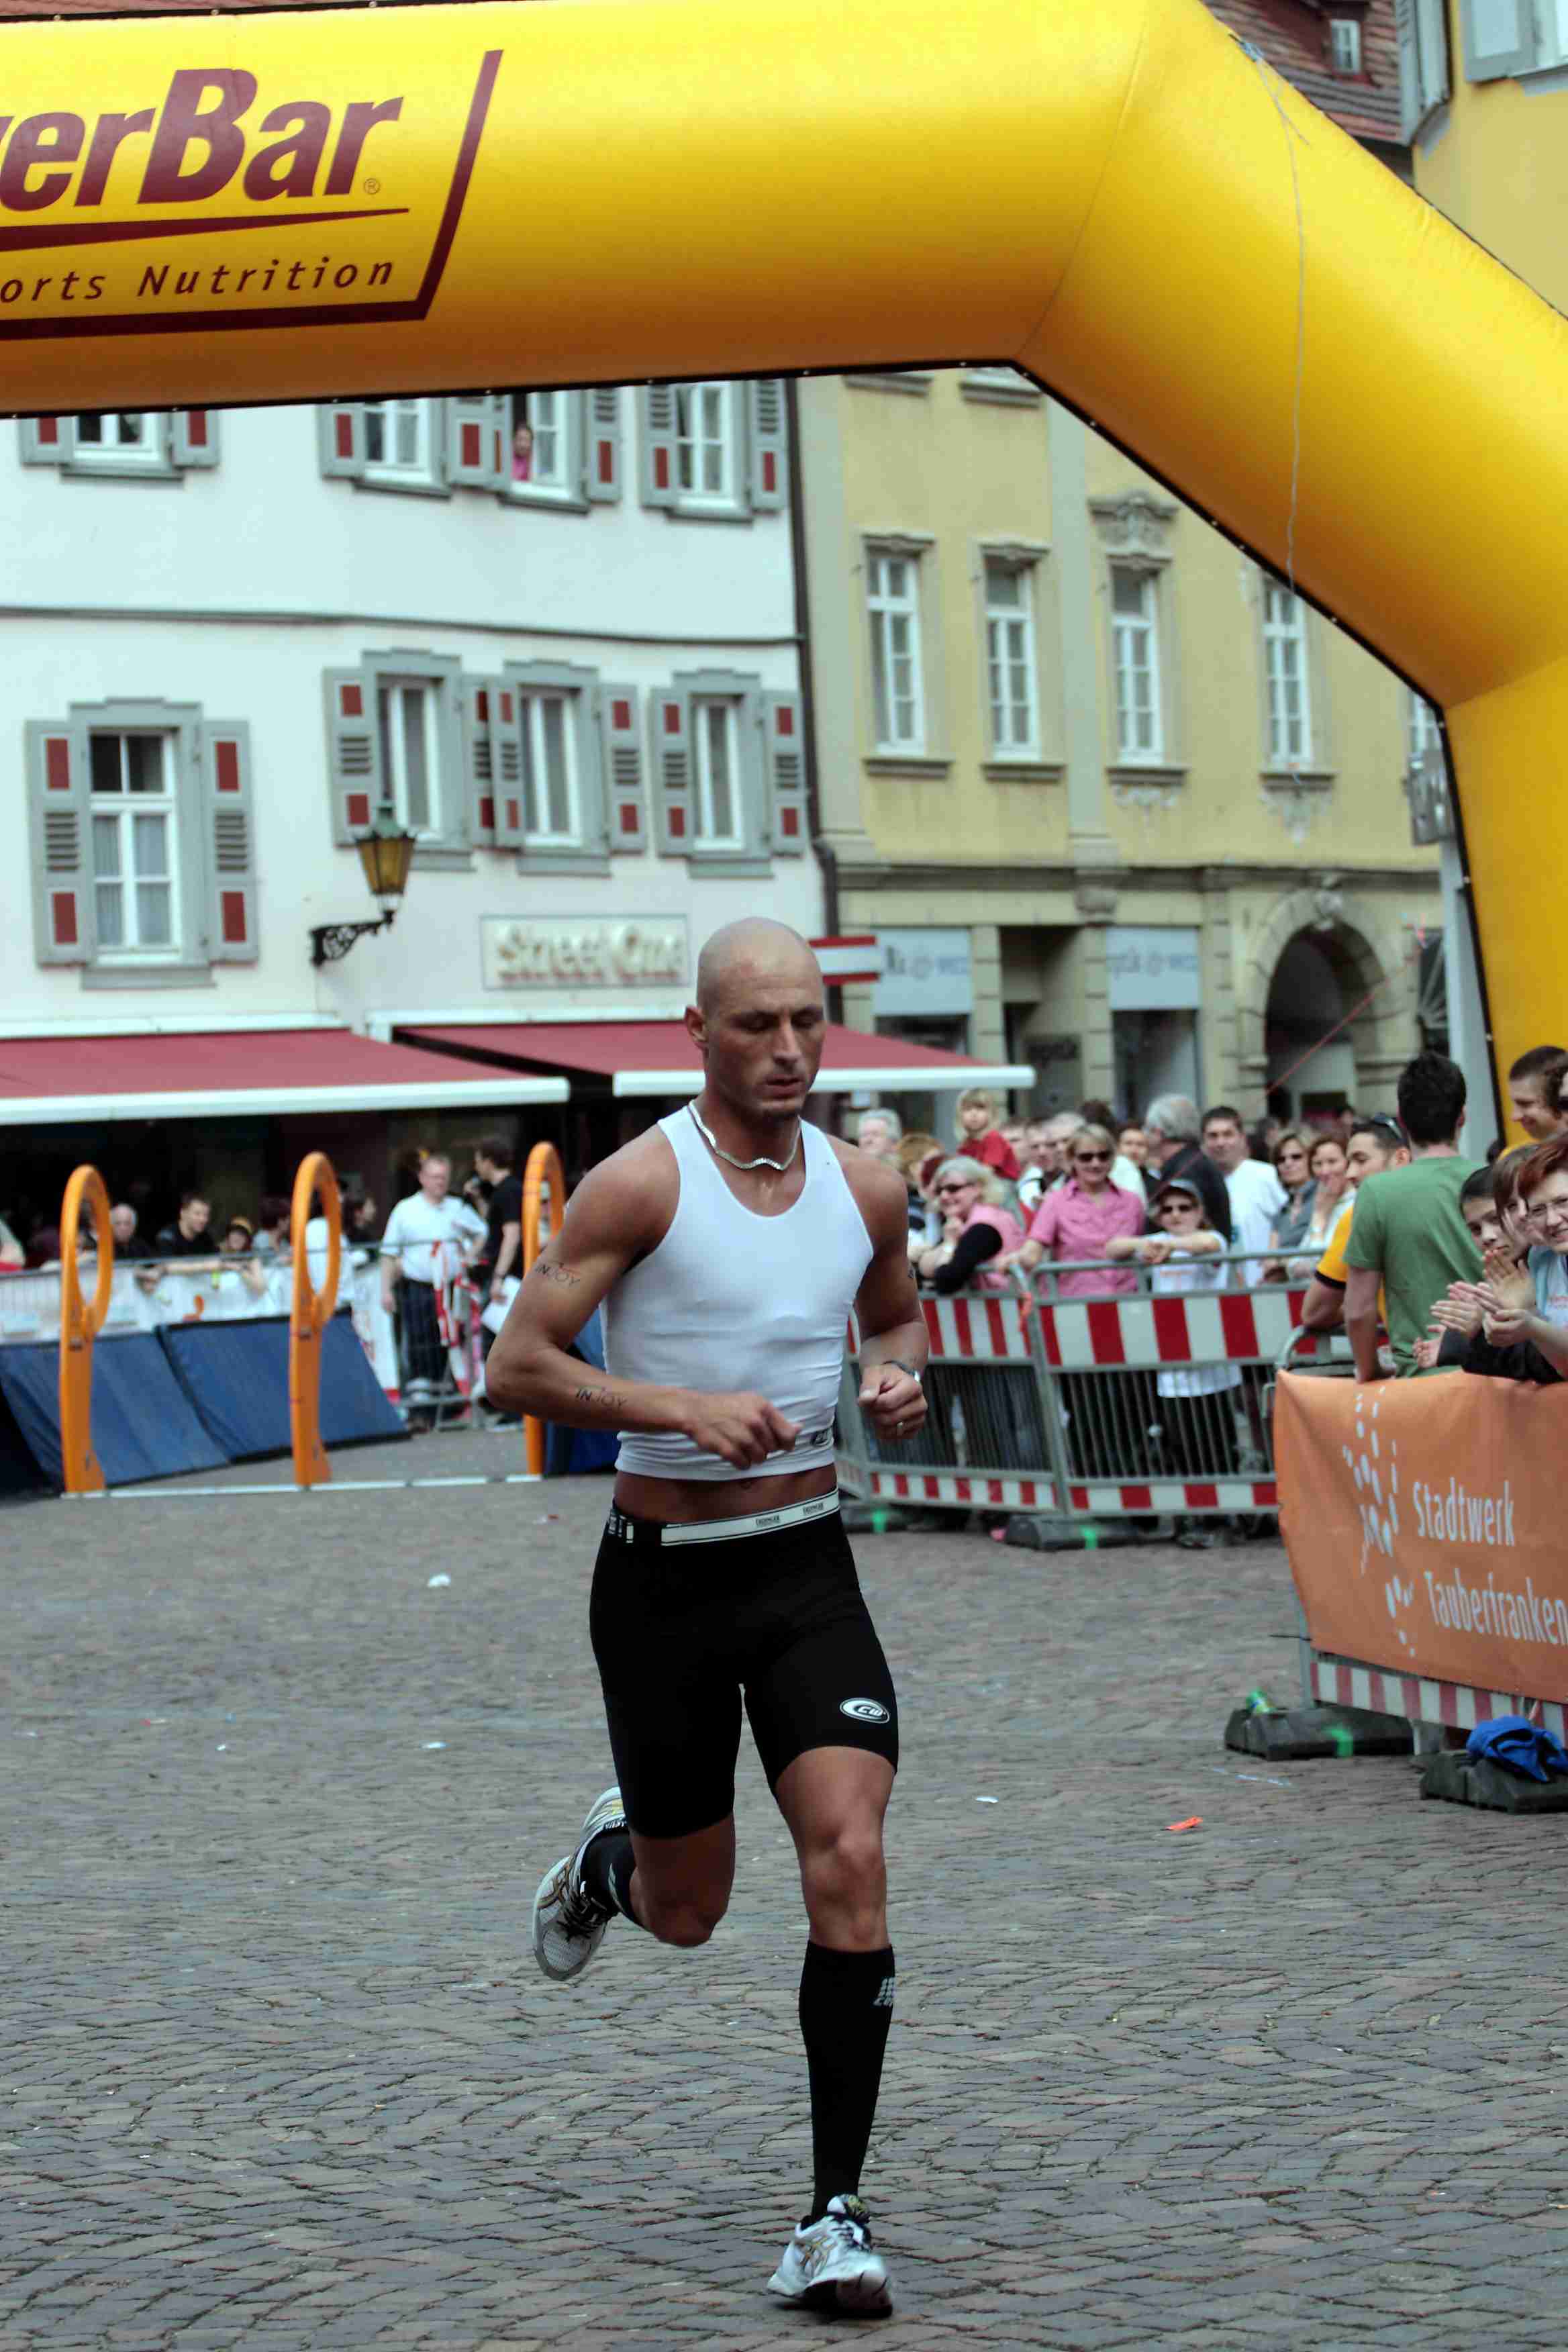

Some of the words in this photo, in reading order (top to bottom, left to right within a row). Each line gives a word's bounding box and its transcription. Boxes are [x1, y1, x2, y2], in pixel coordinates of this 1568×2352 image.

[0, 68, 403, 211] erBar
[137, 256, 393, 297] Nutrition
[1414, 1477, 1515, 1546] Stadtwerk
[1424, 1567, 1568, 1645] Tauberfranken
